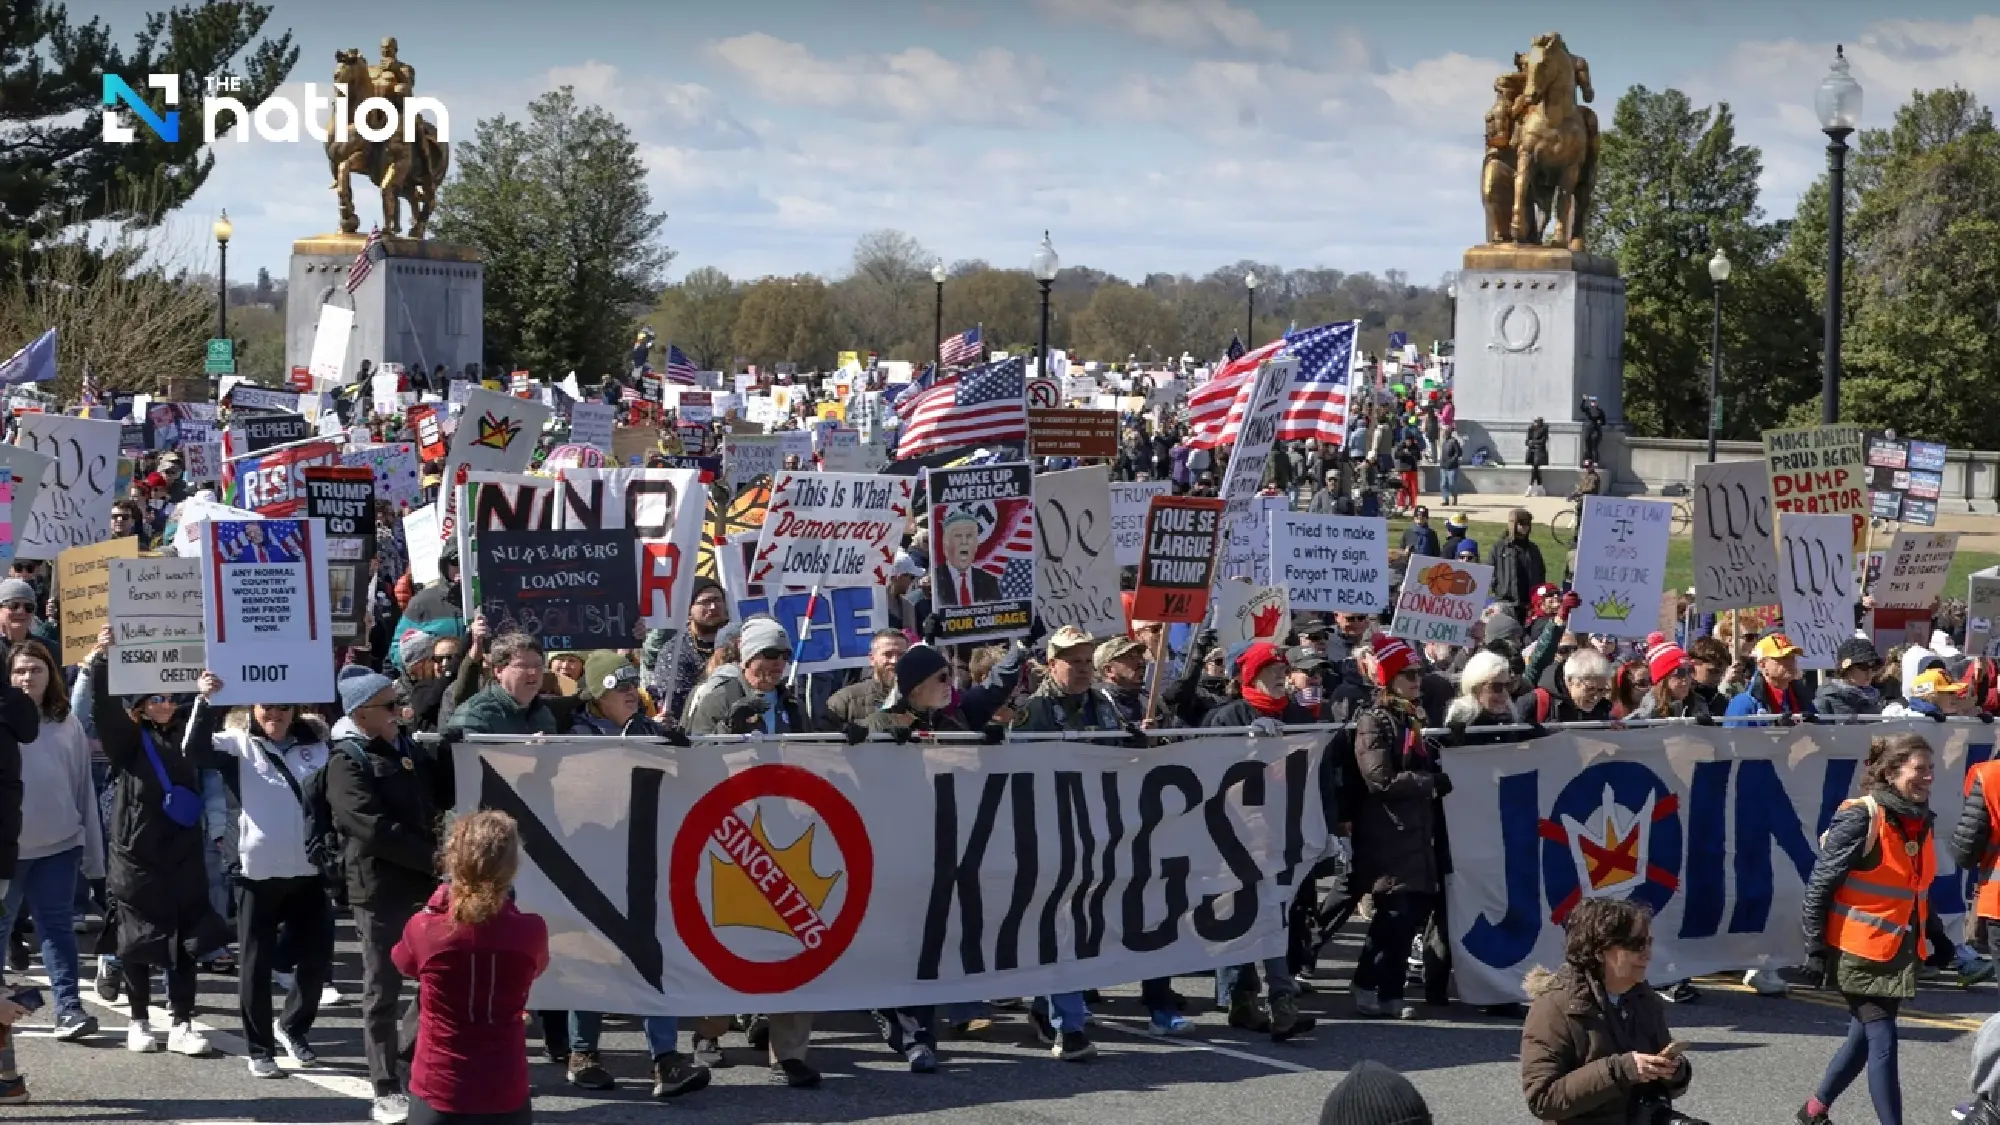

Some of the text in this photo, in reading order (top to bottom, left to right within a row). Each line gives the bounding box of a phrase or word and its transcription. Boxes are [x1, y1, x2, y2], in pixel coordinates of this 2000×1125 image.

[1769, 431, 1810, 452] MAKE
[1771, 451, 1819, 473] PROUD
[1823, 445, 1861, 468] AGAIN
[947, 468, 1014, 487] WAKE UP
[1773, 468, 1849, 497] DUMP
[309, 482, 372, 500] TRUMP
[794, 478, 893, 510] This Is What
[941, 482, 1020, 502] AMERICA!
[1776, 487, 1864, 514] TRAITOR
[316, 500, 367, 518] MUST
[1595, 502, 1665, 522] RULE OF LAW
[1700, 480, 1770, 543] We
[330, 517, 356, 533] GO
[773, 511, 893, 548] Democracy
[1111, 515, 1145, 530] GEST
[1197, 510, 1216, 530] SE
[1286, 522, 1376, 541] Tried to make
[491, 542, 619, 565] NUREMBERG
[1151, 535, 1213, 558] LARGUE
[1293, 546, 1369, 566] a witty sign.
[782, 545, 866, 575] Looks Like
[1782, 535, 1846, 597] We
[137, 564, 161, 583] don't
[165, 564, 195, 581] want
[231, 568, 296, 577] ANY NORMAL
[521, 571, 600, 590] LOADING
[1151, 559, 1206, 583] TRUMP
[1285, 565, 1379, 584] Forgot TRUMP
[1594, 566, 1650, 585] RULE OF ONE
[232, 587, 297, 596] WOULD HAVE
[240, 578, 288, 586] COUNTRY
[1705, 562, 1777, 604] People
[128, 585, 160, 601] Person
[165, 589, 183, 600] as
[242, 597, 290, 605] REMOVED
[1289, 588, 1333, 604] CAN'T
[1337, 589, 1378, 607] READ.
[241, 606, 291, 614] HIM FROM
[1161, 594, 1192, 615] YA!
[1399, 591, 1473, 622] CONGRESS
[241, 615, 292, 623] OFFICE BY
[941, 611, 1028, 632] YOUR COURAGE
[1394, 616, 1421, 634] GET
[542, 635, 573, 649] ICE
[1789, 620, 1844, 662] Peopl
[121, 648, 180, 664] RESIGN MR
[241, 664, 289, 683] IDIOT
[917, 748, 1310, 980] KINGS!
[1462, 757, 1860, 969] JOIN
[714, 815, 829, 949] SINCE 1776
